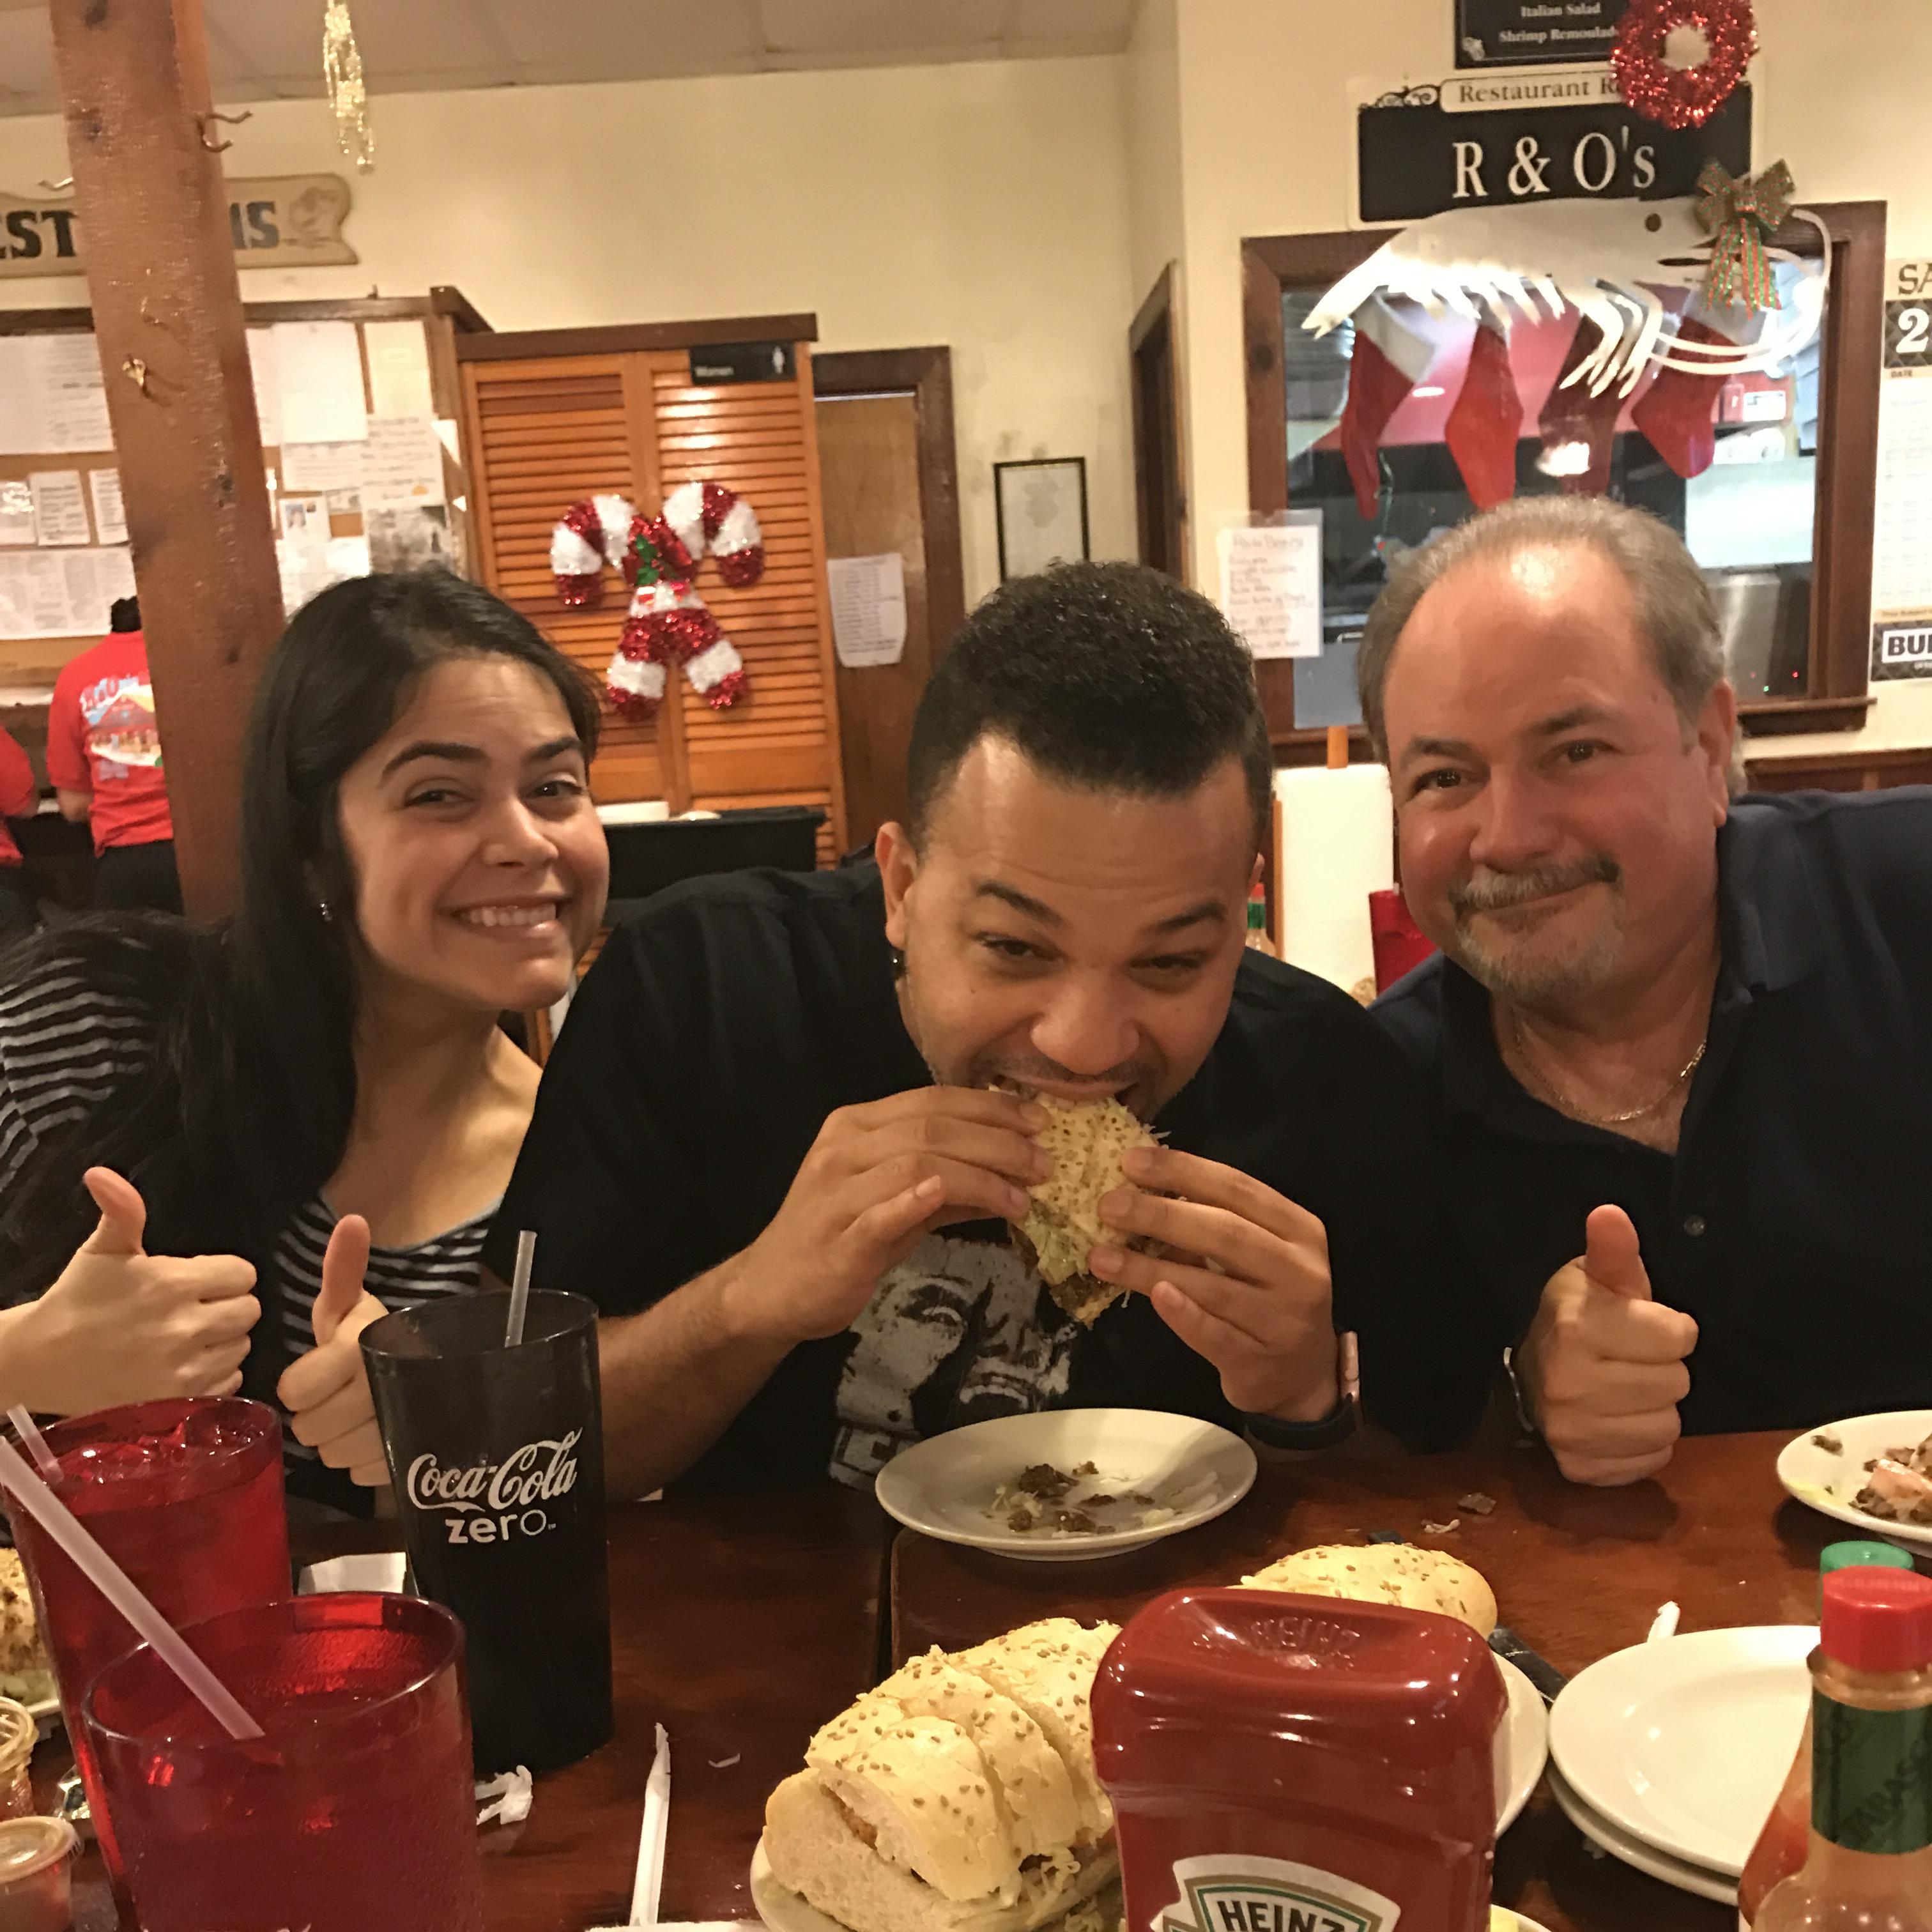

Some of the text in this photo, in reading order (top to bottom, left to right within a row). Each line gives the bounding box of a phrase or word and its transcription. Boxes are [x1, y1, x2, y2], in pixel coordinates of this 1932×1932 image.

[1521, 3, 1601, 17] Italian Salad
[1499, 30, 1547, 44] Shrimp
[1459, 80, 1589, 103] Restaurant
[1452, 125, 1656, 199] R & O's
[407, 1426, 583, 1513] Coca-Cola
[445, 1508, 547, 1544] zero
